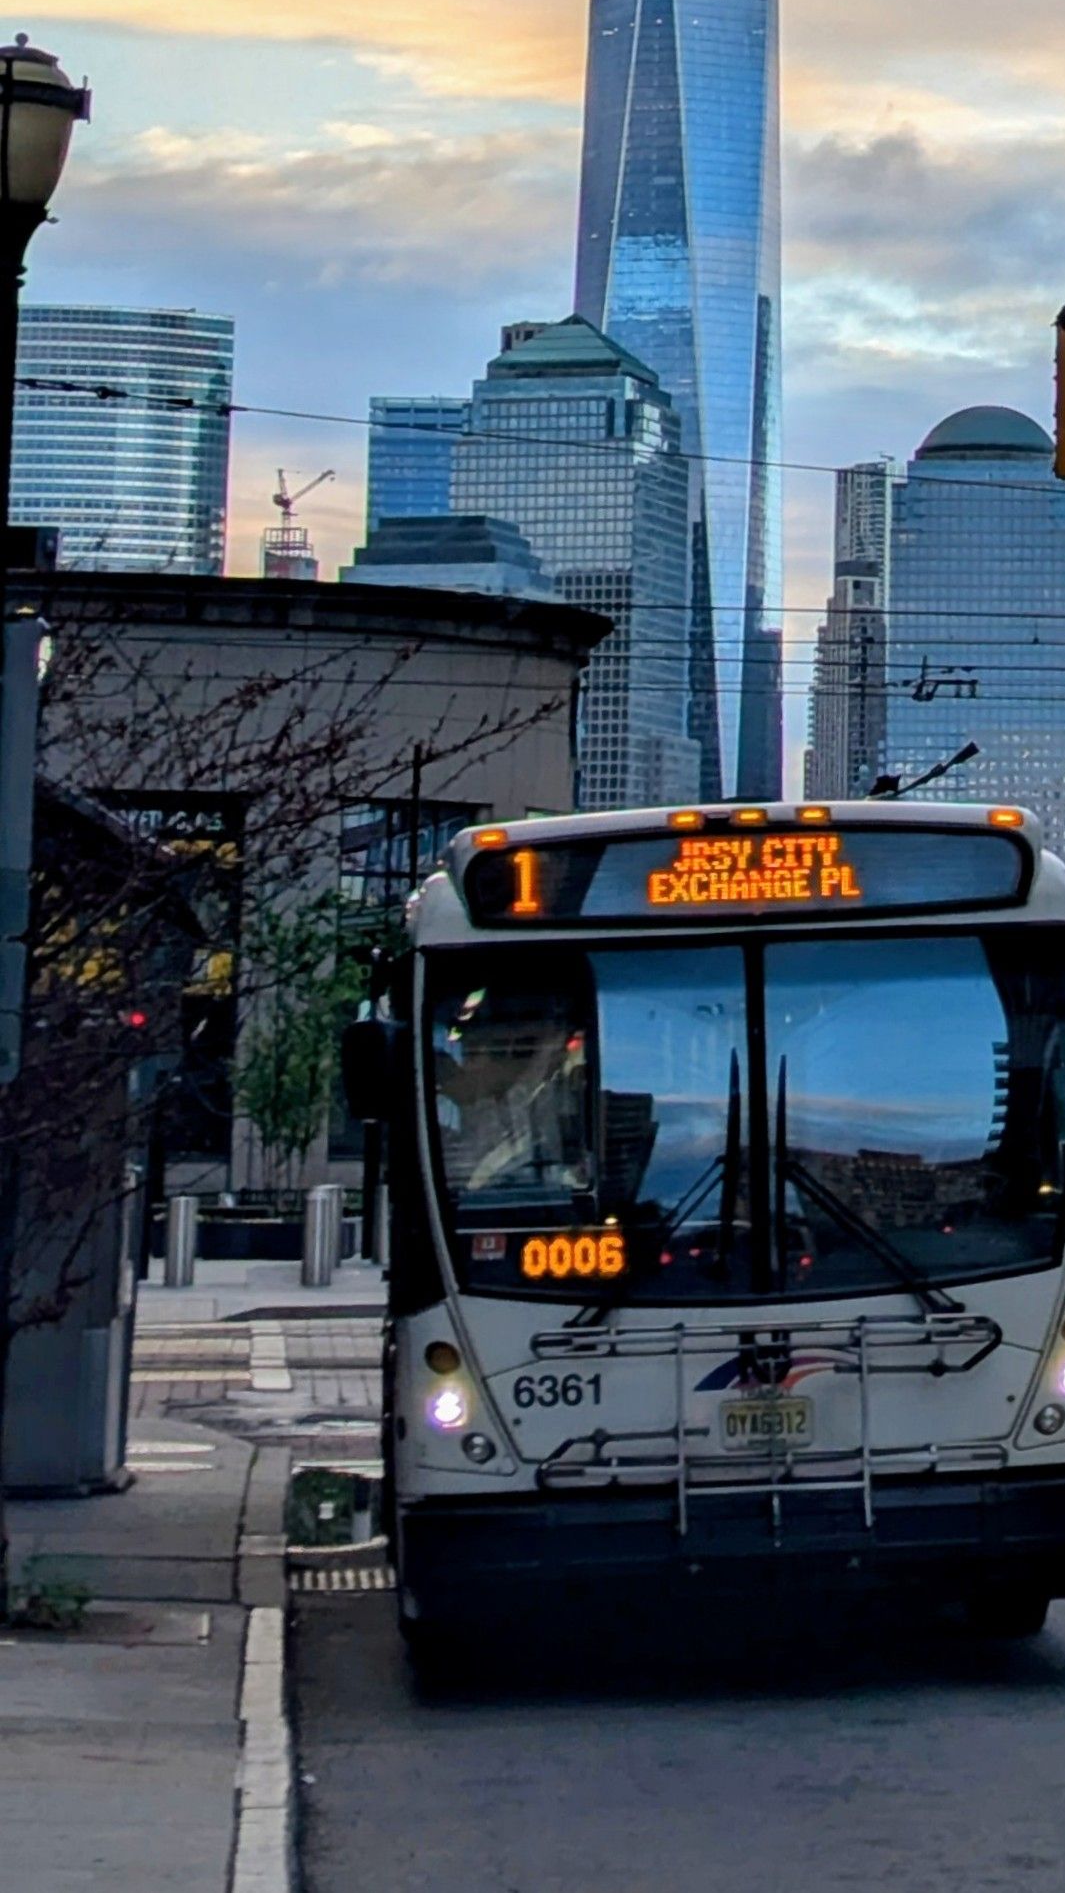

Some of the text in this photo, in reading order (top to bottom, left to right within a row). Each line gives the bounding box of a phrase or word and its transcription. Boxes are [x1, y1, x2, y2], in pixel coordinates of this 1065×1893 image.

[673, 835, 839, 872] JRSY CITY
[513, 851, 538, 913] 1
[649, 865, 861, 904] EXCHANGE PL
[523, 1236, 625, 1278] 0006
[513, 1373, 602, 1408] 6361
